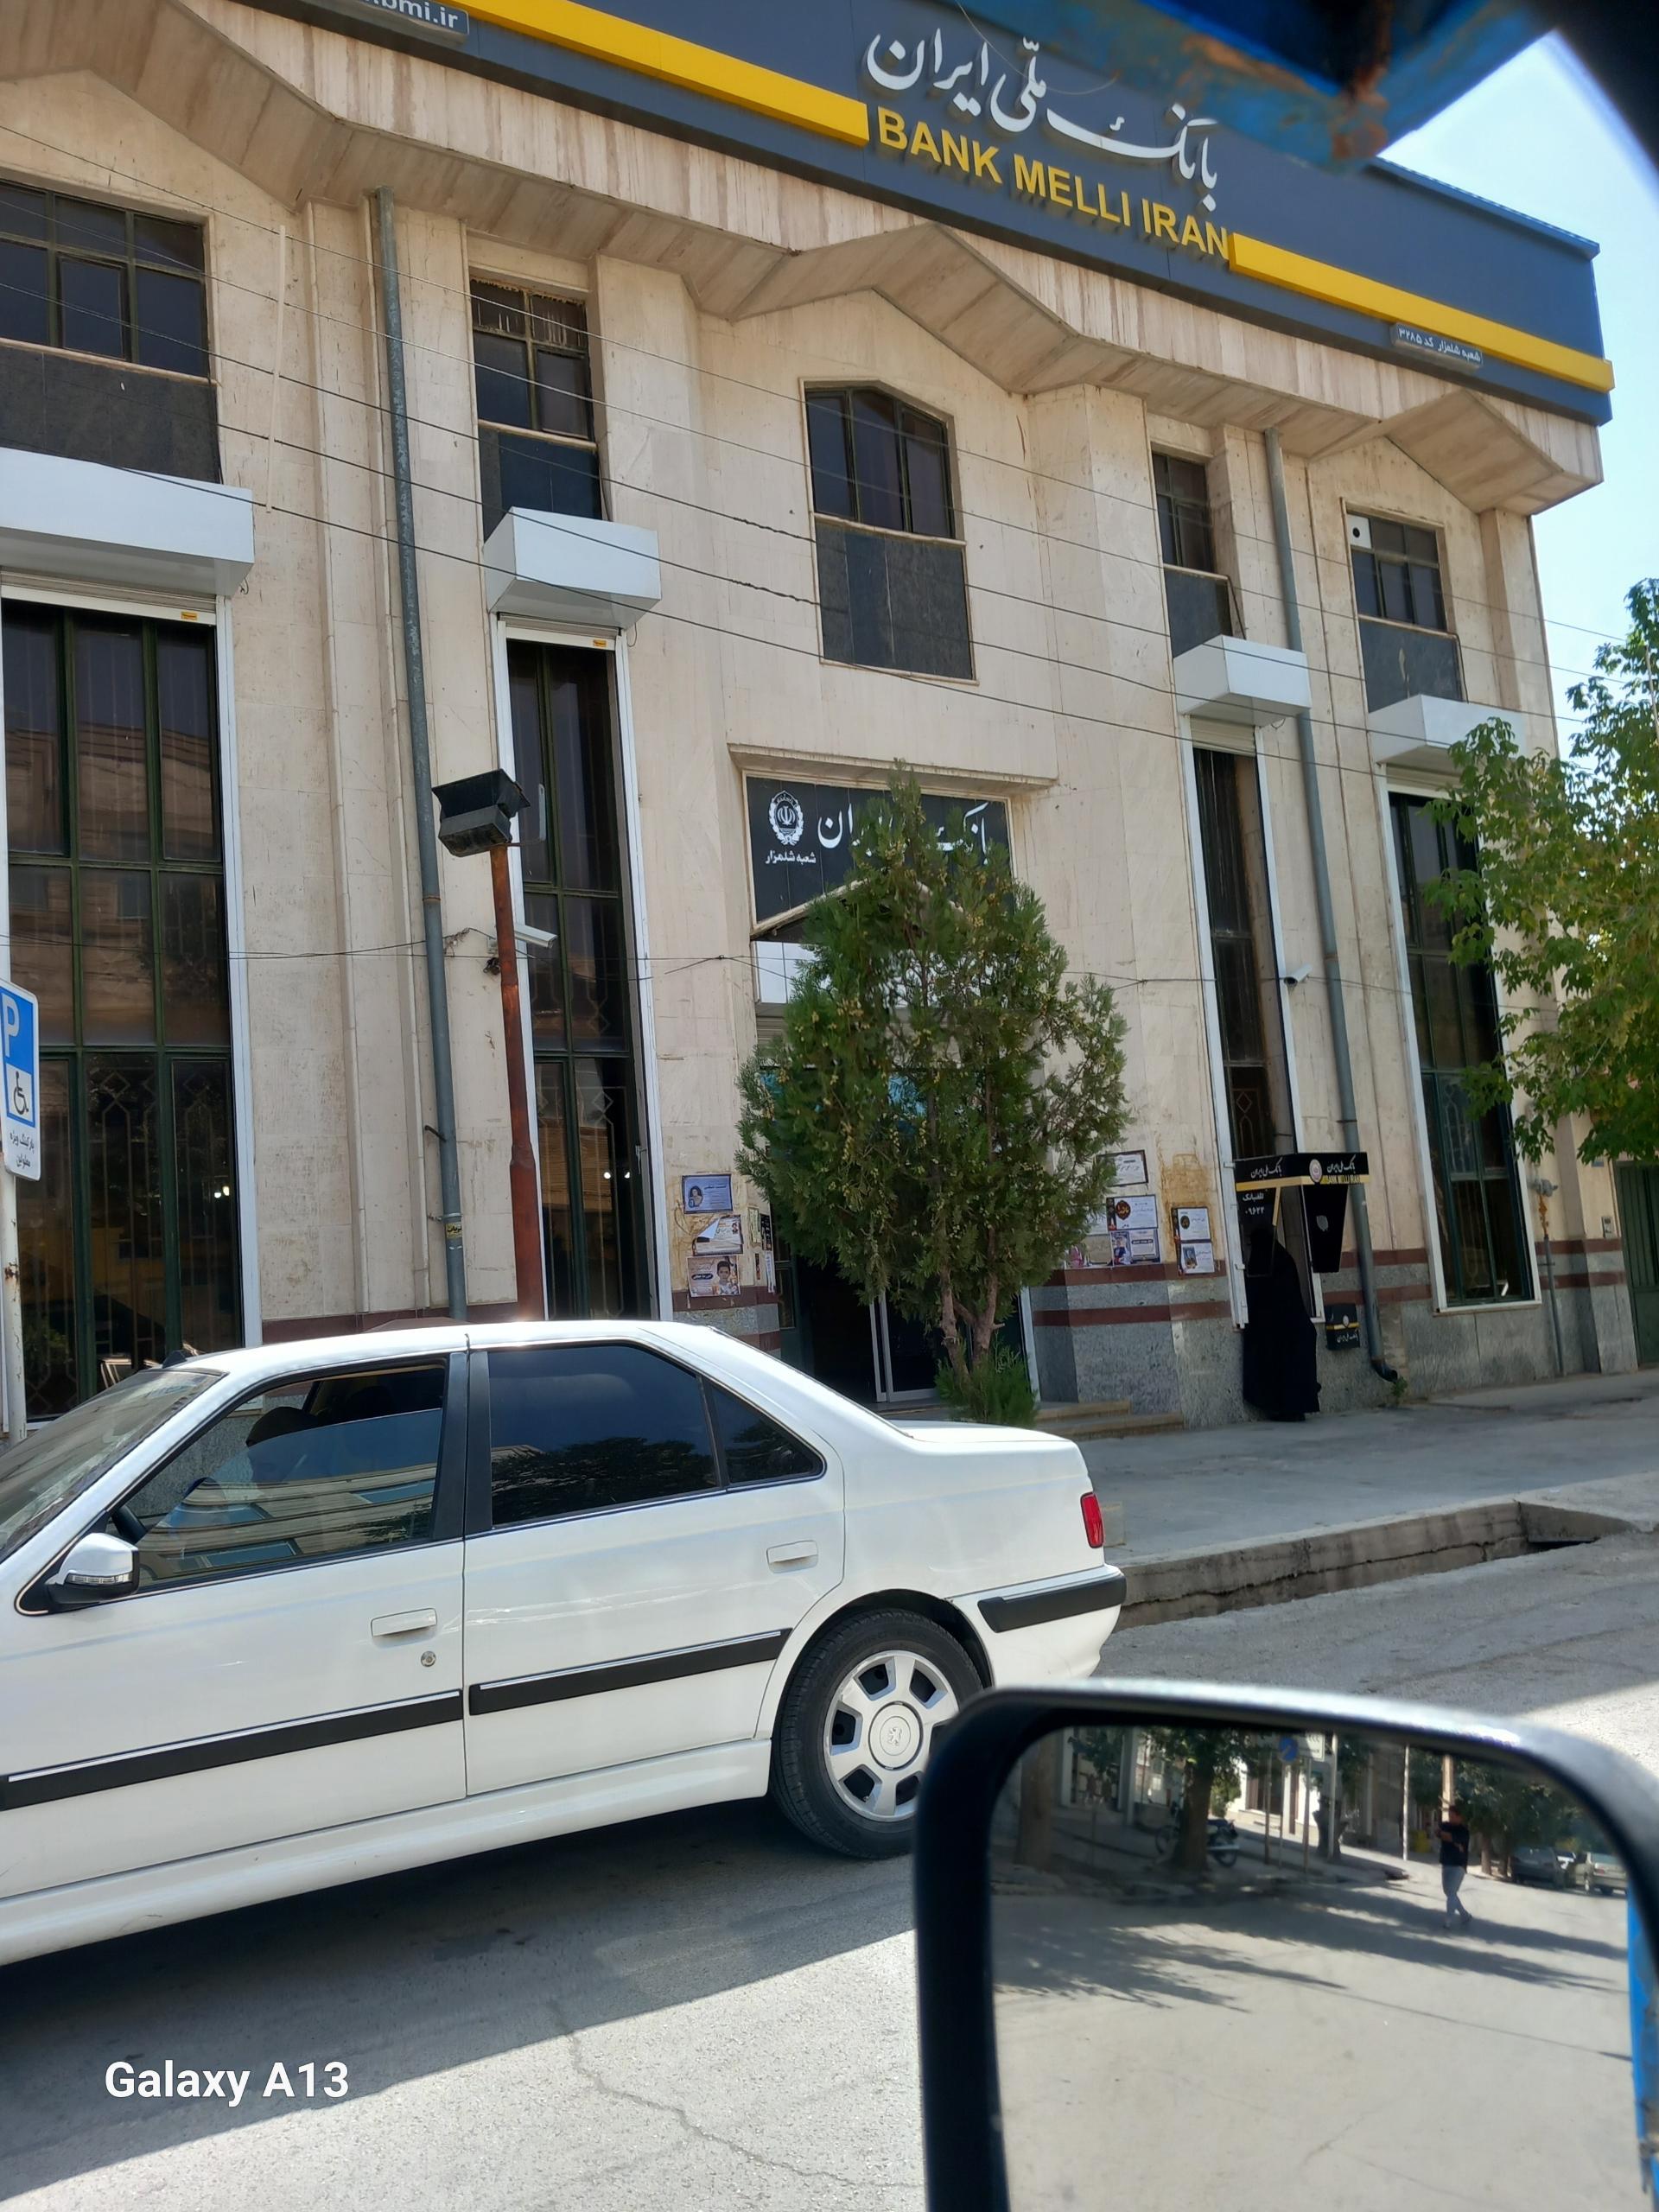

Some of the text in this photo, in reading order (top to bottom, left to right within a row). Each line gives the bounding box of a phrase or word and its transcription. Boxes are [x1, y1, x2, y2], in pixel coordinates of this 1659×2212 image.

[866, 28, 989, 117] ایران
[877, 105, 1230, 261] BANK MELLI IRAN
[1046, 103, 1218, 213] بانک
[765, 849, 817, 865] شعبه شلمزار
[3, 995, 20, 1058] P
